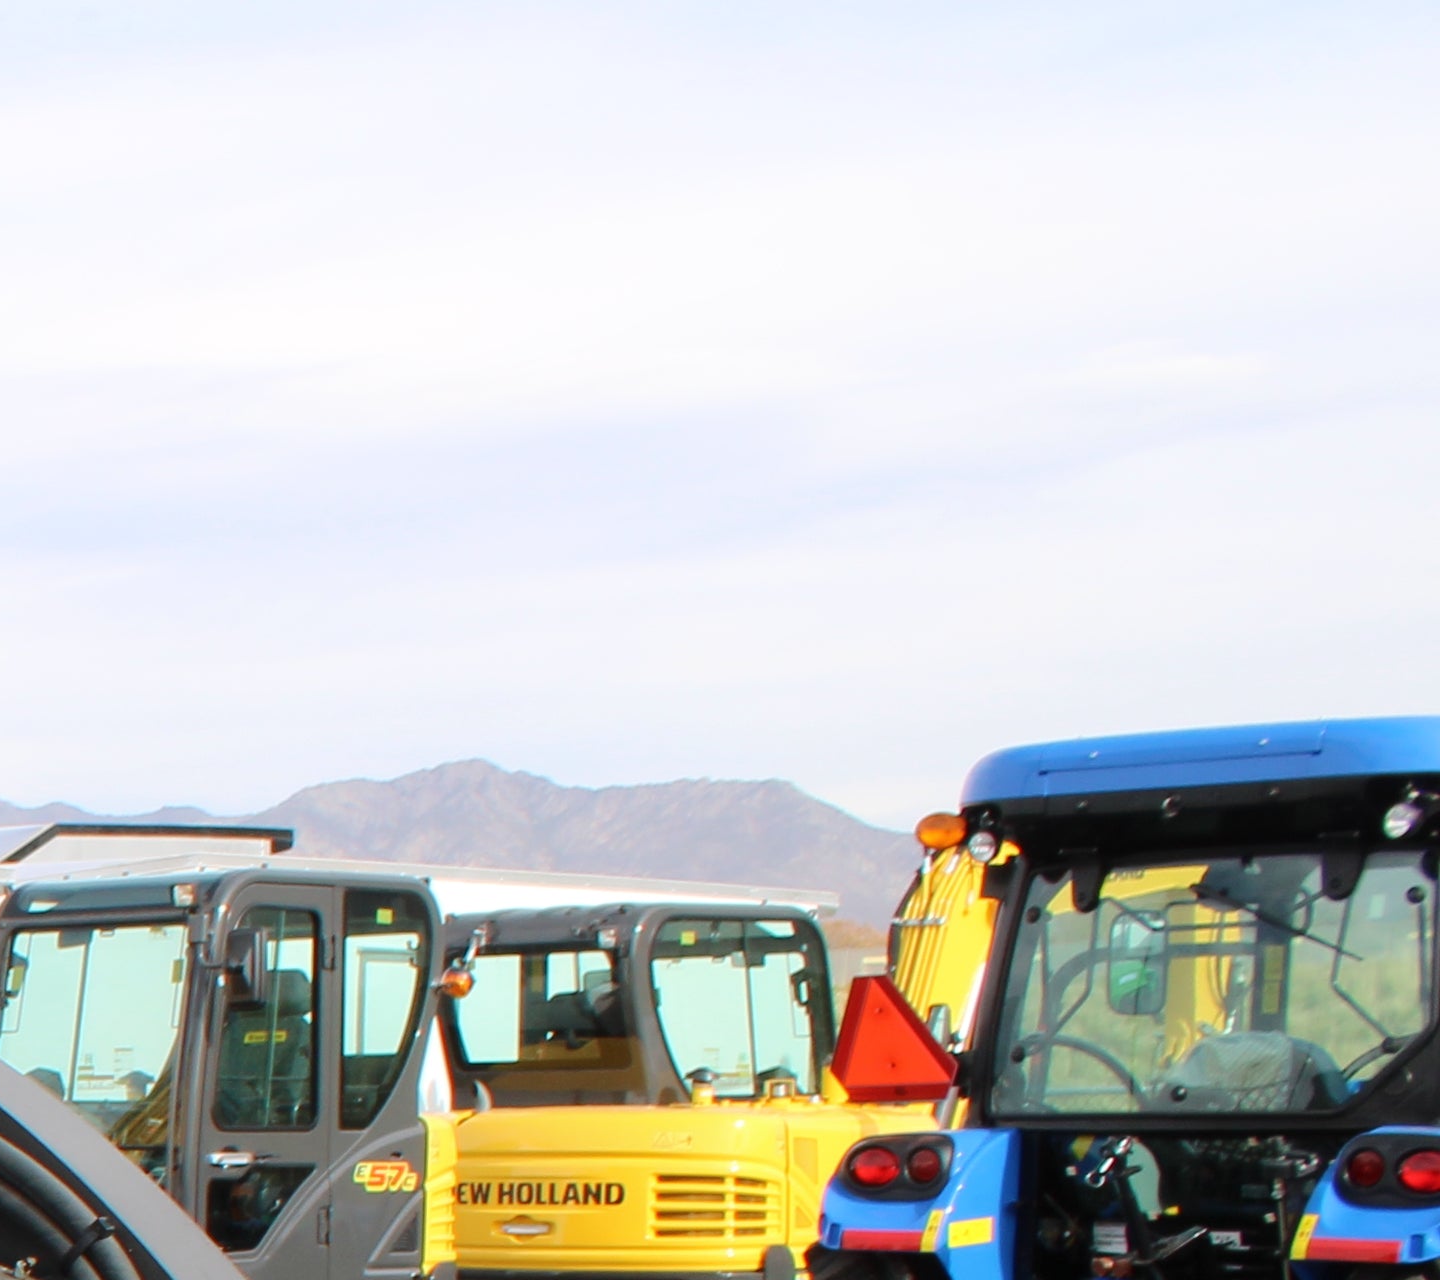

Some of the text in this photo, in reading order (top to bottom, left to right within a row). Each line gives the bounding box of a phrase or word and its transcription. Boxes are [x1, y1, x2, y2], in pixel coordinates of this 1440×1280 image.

[353, 1163, 418, 1190] E57C
[457, 1182, 625, 1206] EW HOLLAND
